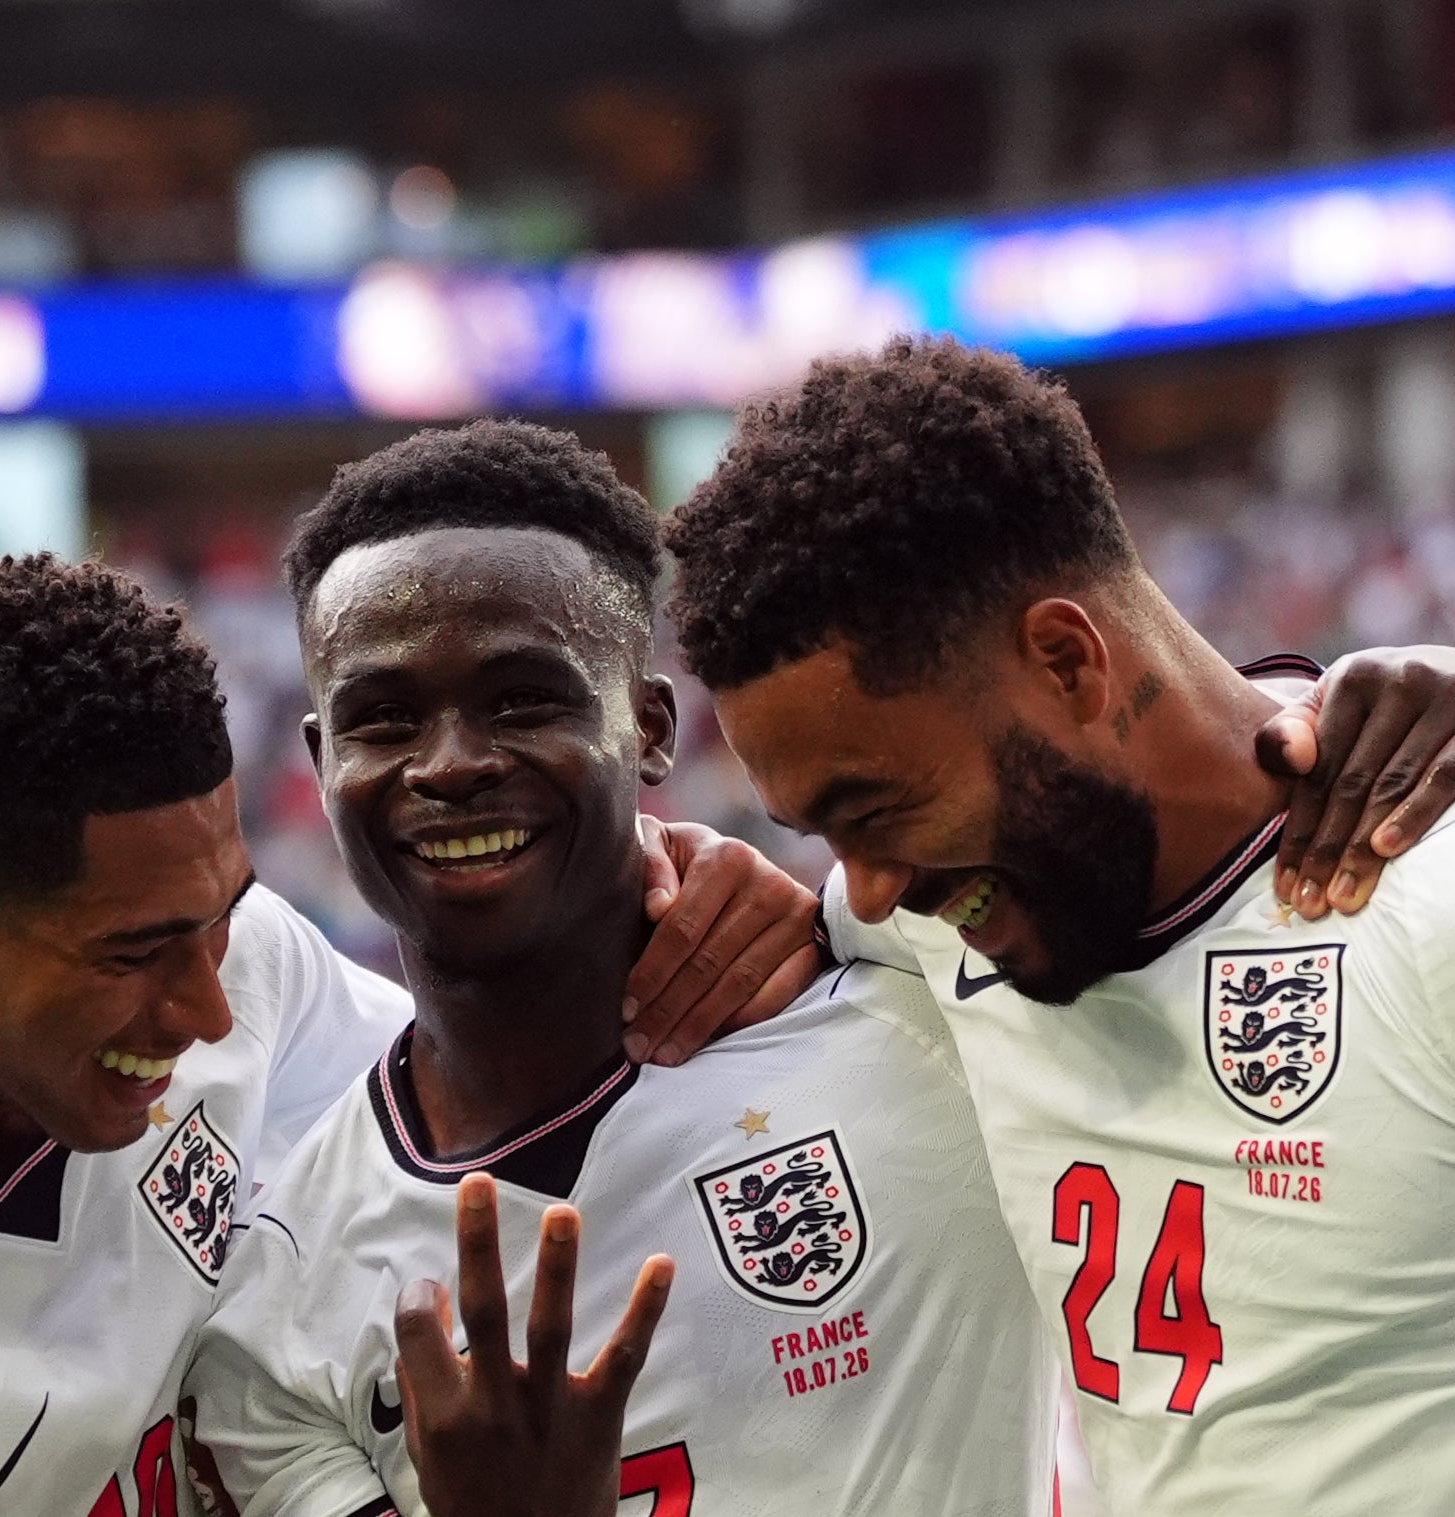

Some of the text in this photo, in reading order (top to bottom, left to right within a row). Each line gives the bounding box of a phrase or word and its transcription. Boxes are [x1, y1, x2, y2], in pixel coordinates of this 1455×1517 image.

[1235, 1140, 1325, 1168] FRANCE
[1247, 1168, 1321, 1203] 18.07.26
[1052, 1162, 1223, 1415] 24
[771, 1311, 869, 1365] FRANCE
[784, 1347, 869, 1397] 18.07.26
